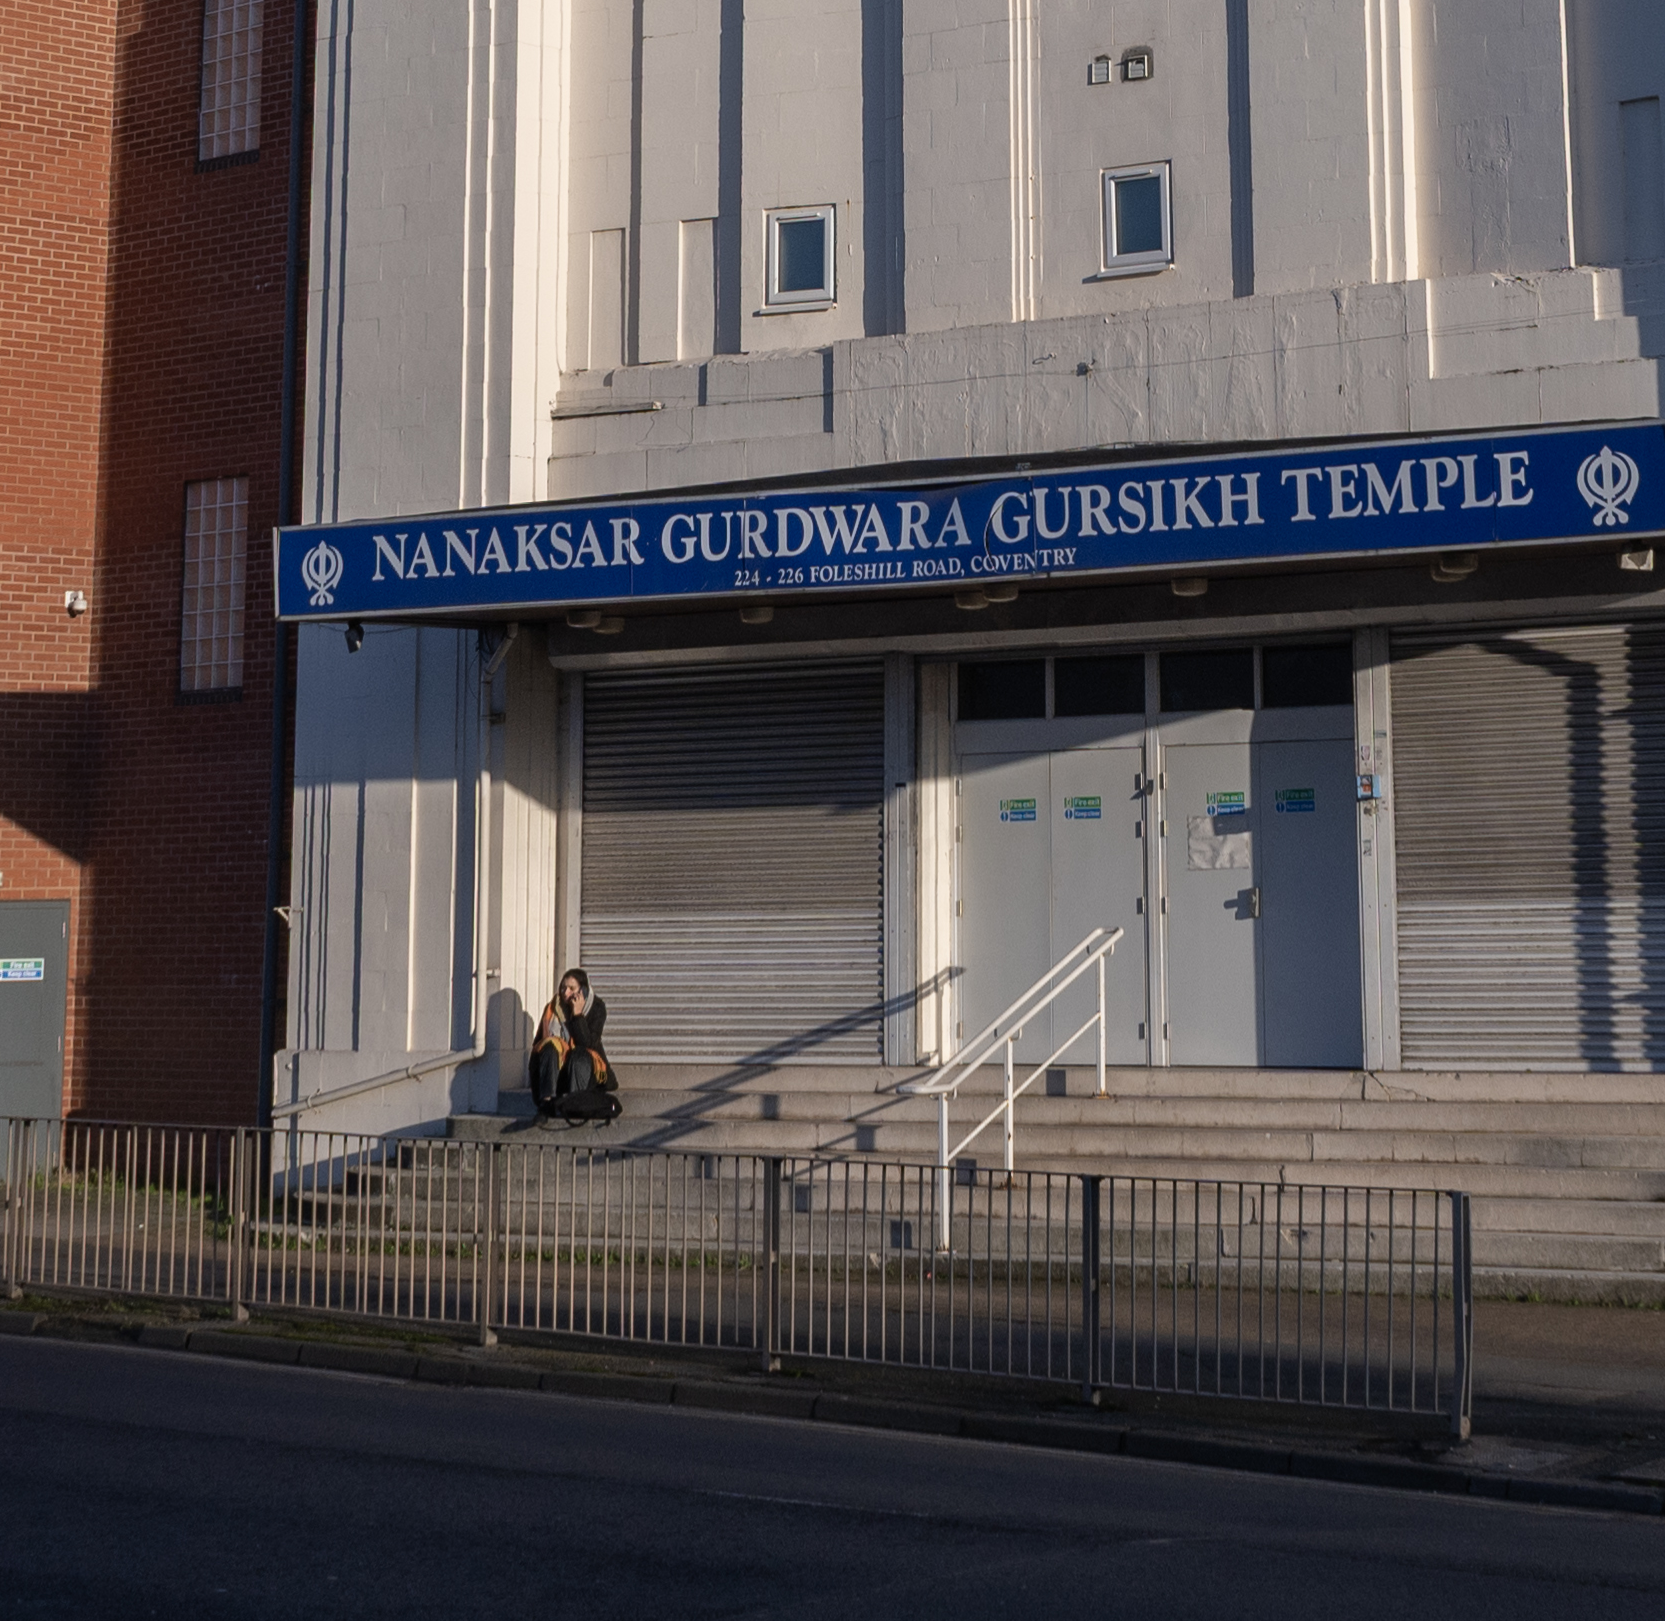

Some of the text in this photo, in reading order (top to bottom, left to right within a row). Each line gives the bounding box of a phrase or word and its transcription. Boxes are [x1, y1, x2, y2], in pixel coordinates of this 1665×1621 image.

[372, 450, 1534, 581] NANAKSAR GURDWARA GURSIKH TEMPLE
[734, 570, 760, 586] 224
[777, 568, 804, 585] 226
[810, 562, 906, 583] FOLESHILL
[913, 557, 965, 578] ROAD,
[969, 547, 1077, 574] COVENTRY
